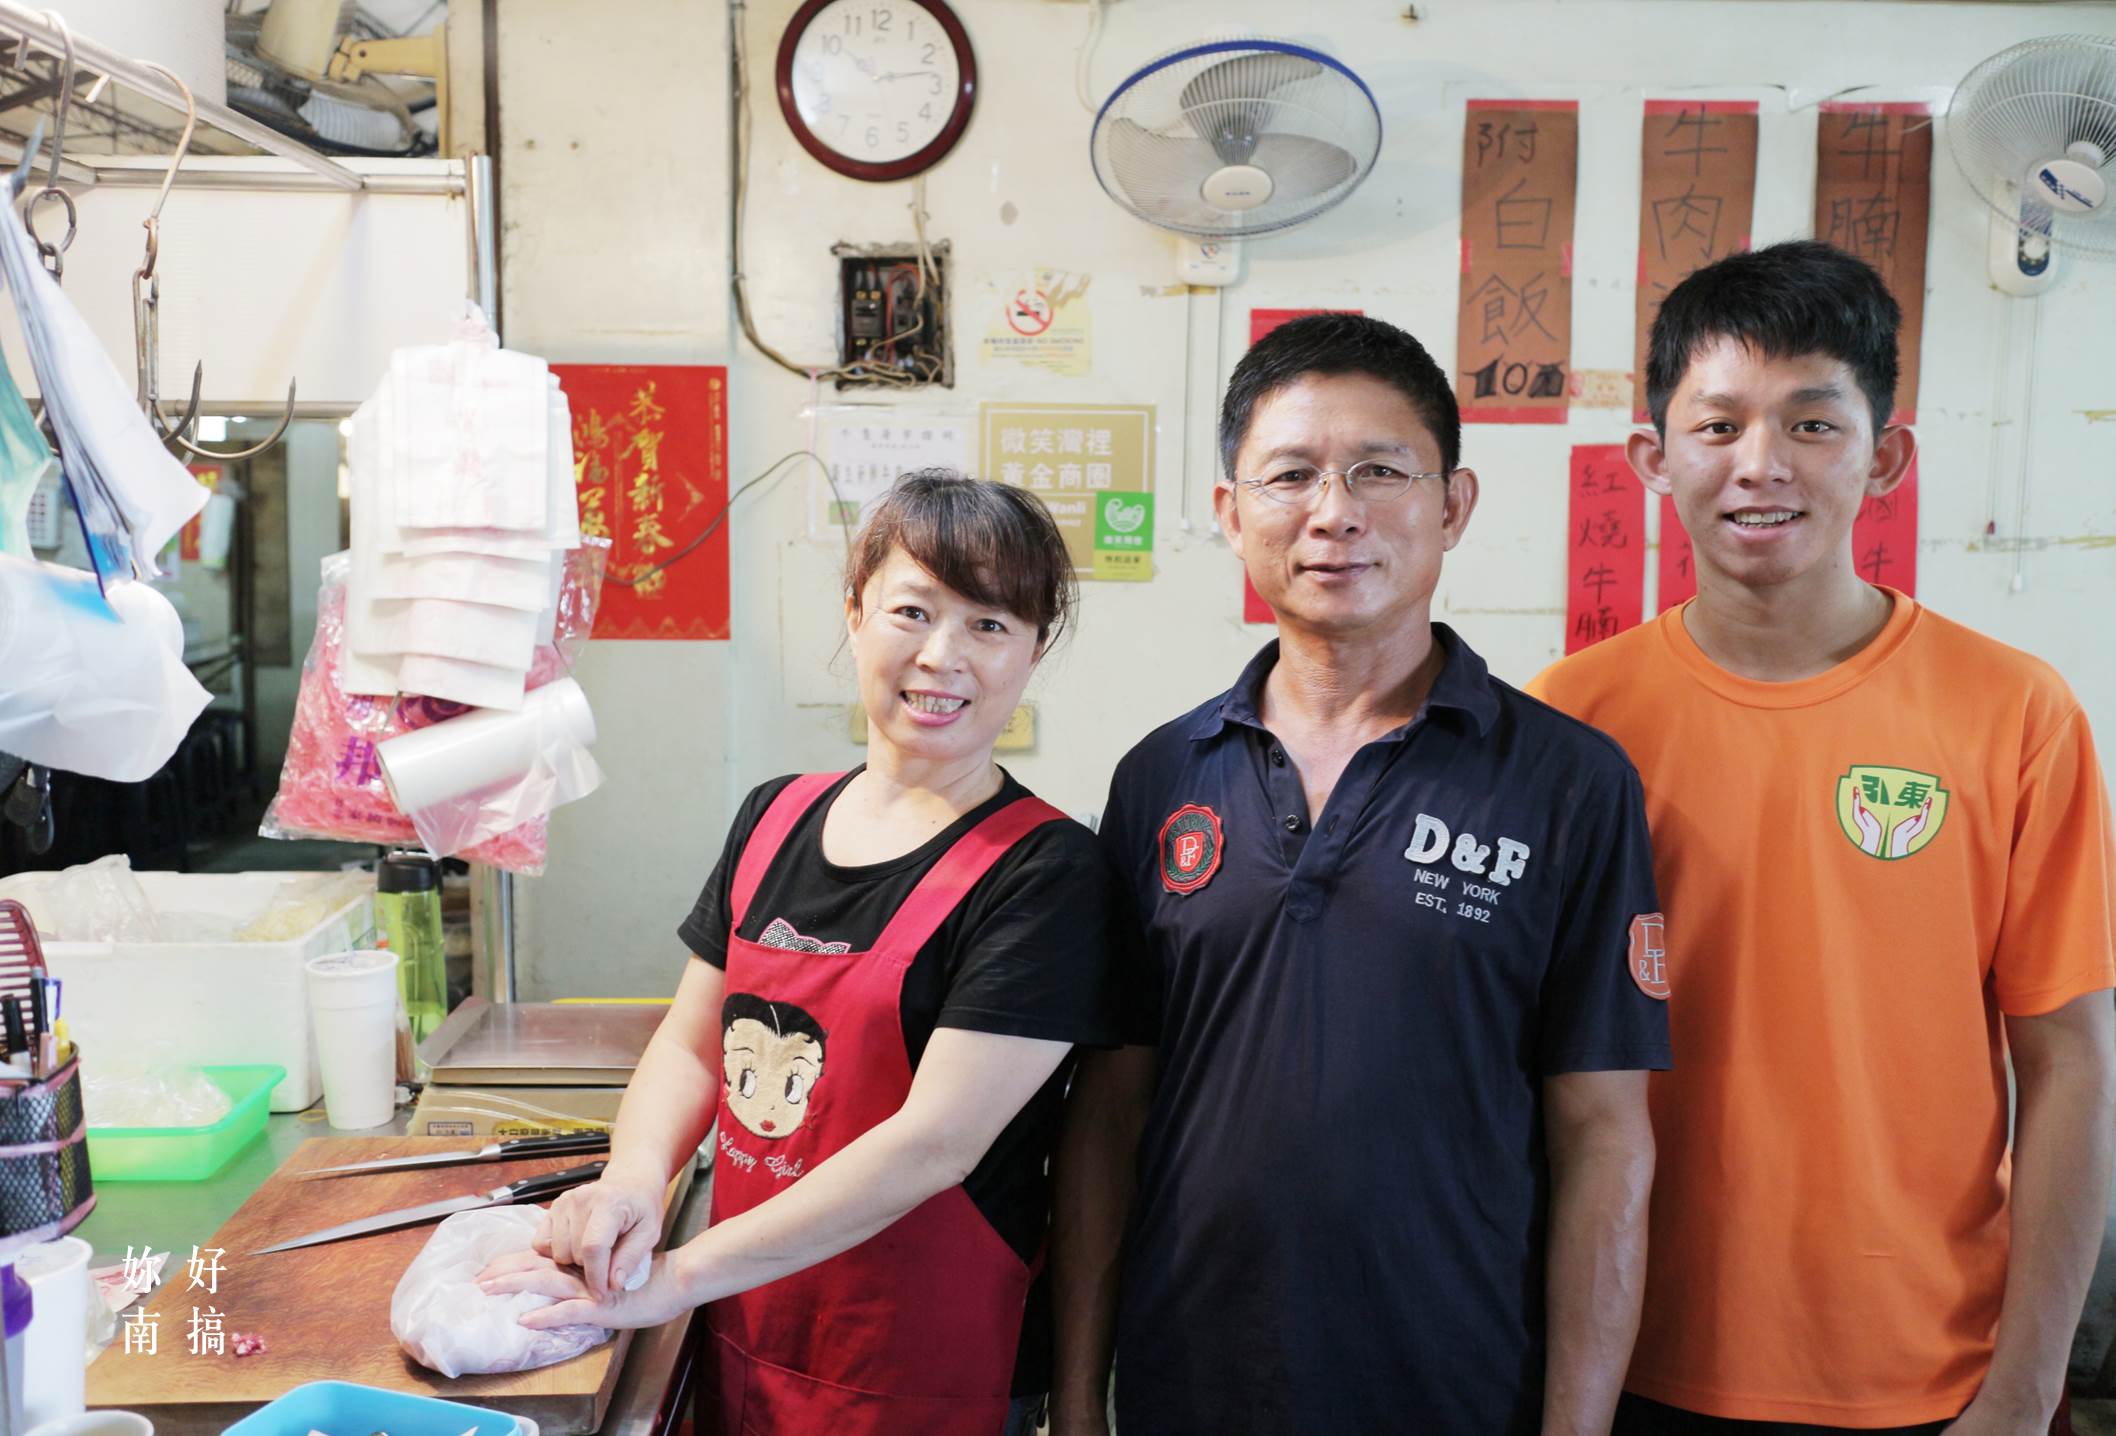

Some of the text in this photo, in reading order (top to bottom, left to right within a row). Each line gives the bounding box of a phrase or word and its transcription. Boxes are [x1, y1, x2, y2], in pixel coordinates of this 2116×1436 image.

[843, 14, 861, 36] 11
[871, 9, 893, 32] 12
[907, 20, 915, 41] 1
[822, 34, 842, 56] 10
[920, 43, 936, 65] 2
[929, 73, 942, 96] 3
[918, 102, 932, 122] 4
[838, 114, 851, 136] 7
[896, 121, 910, 143] 5
[865, 126, 879, 148] 6
[1001, 427, 1112, 456] 微笑灣裡
[1404, 813, 1530, 887] D&F
[1413, 868, 1501, 905] NEW YORK
[1415, 892, 1490, 923] EST. 1892
